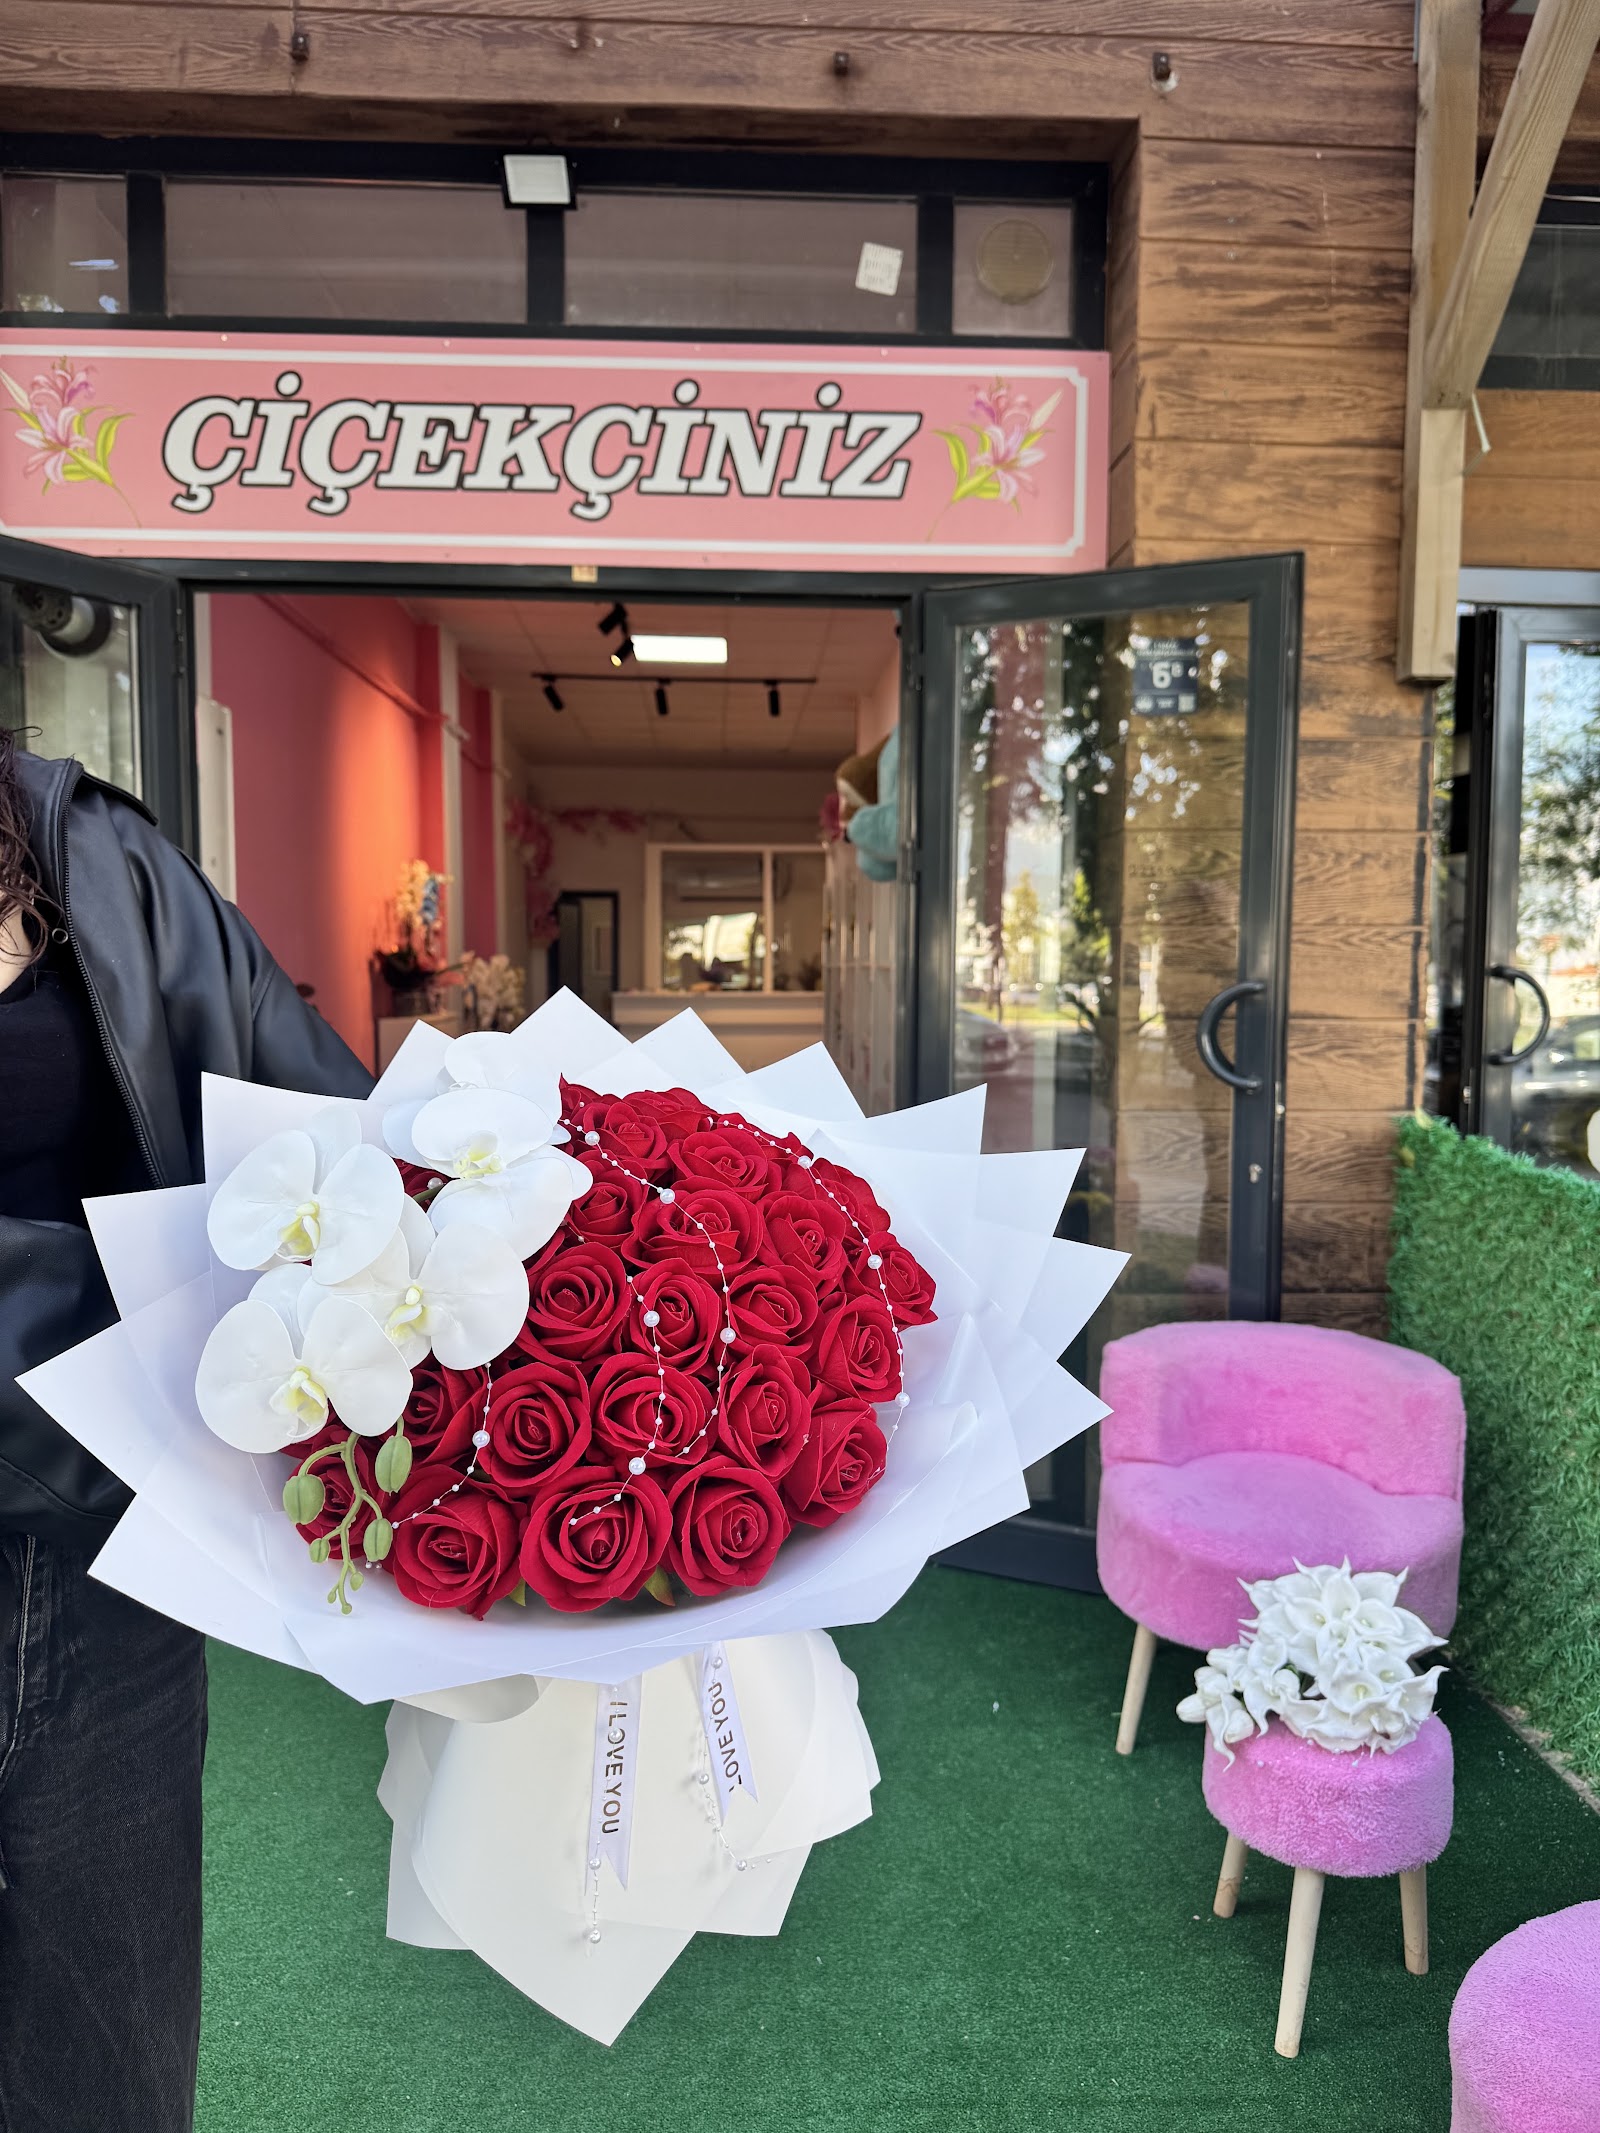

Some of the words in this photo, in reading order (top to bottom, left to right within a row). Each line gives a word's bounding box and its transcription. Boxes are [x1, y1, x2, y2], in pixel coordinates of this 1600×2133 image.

[162, 370, 923, 522] ÇİÇEKÇİNİZ
[708, 1682, 729, 1733] YOU
[605, 1713, 626, 1777] LOVE
[602, 1782, 622, 1834] YOU
